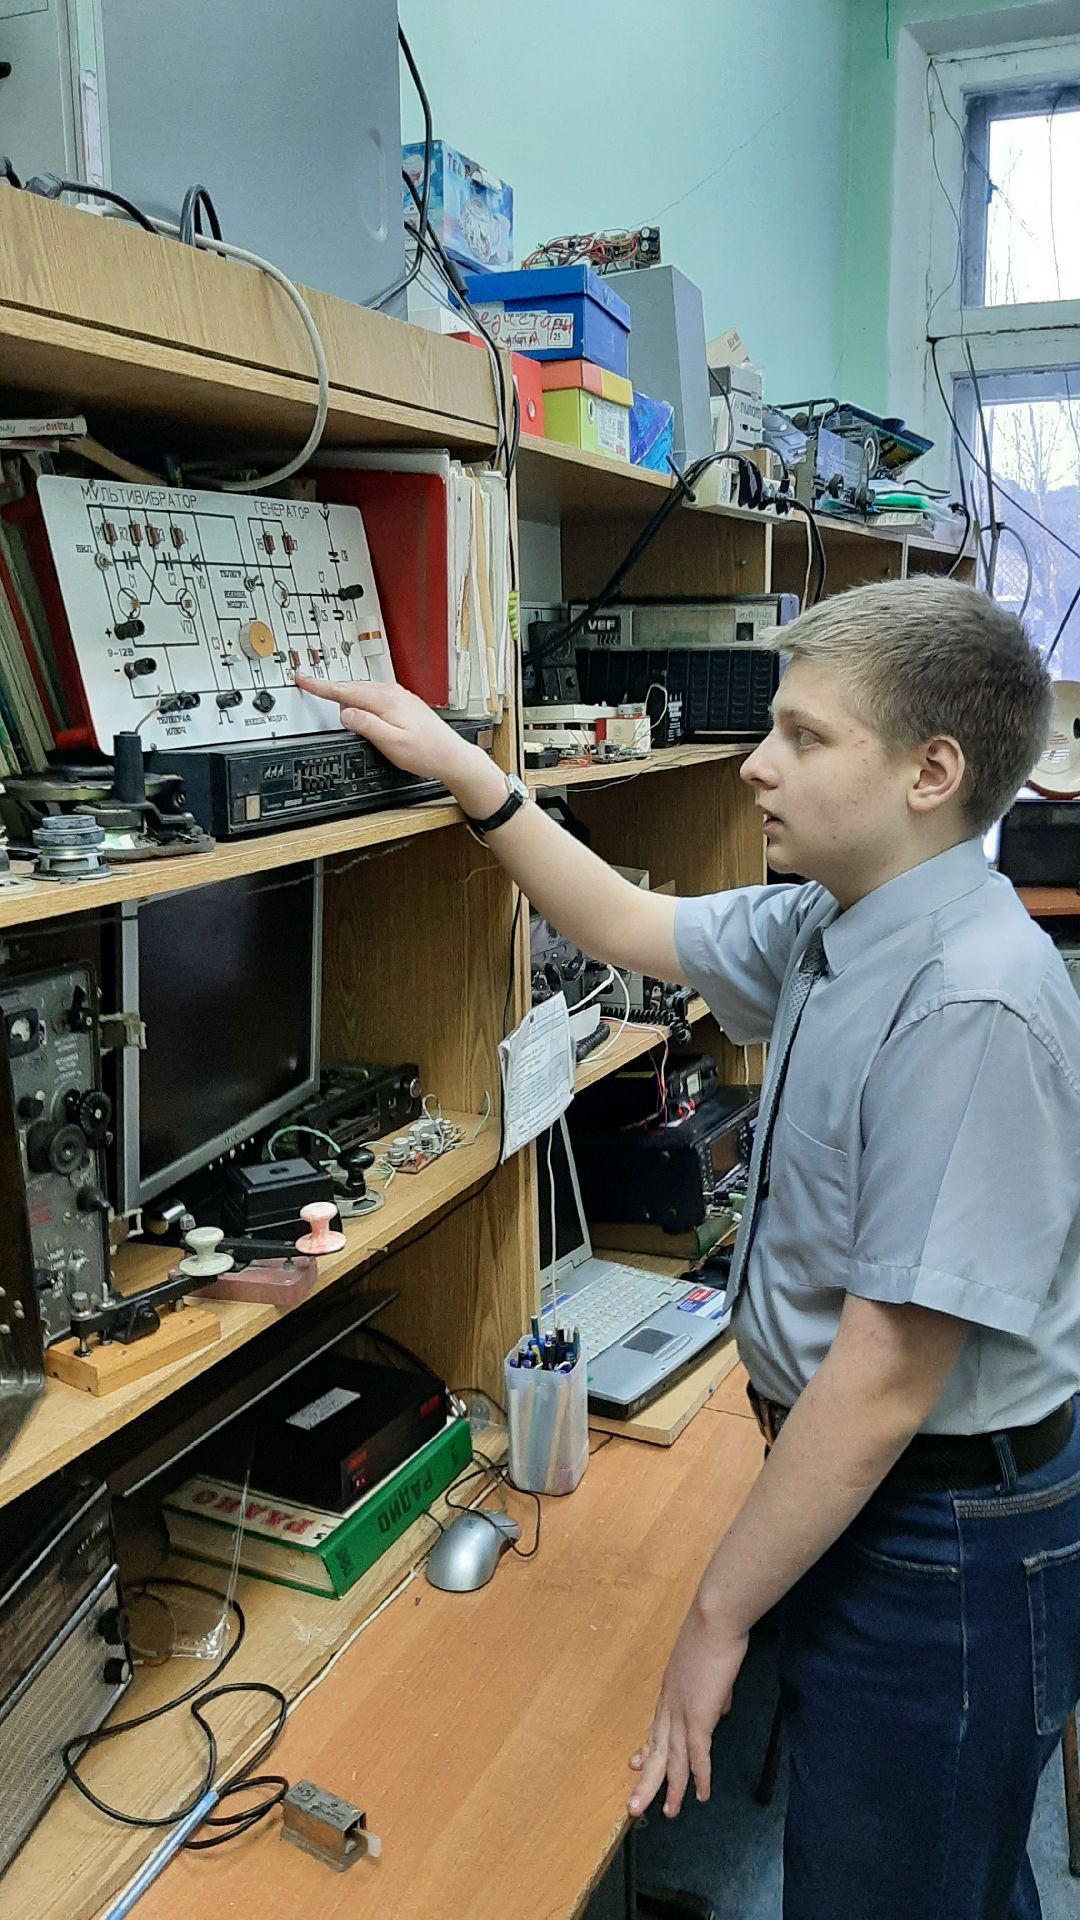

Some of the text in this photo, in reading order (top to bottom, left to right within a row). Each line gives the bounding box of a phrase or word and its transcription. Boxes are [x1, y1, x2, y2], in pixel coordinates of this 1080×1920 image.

[80, 485, 197, 508] МУЛЬТИВИБРАТОР
[253, 501, 310, 519] ГЕНЕРАТОР
[192, 1490, 316, 1535] РАДИО
[377, 1469, 433, 1534] РАДИО
